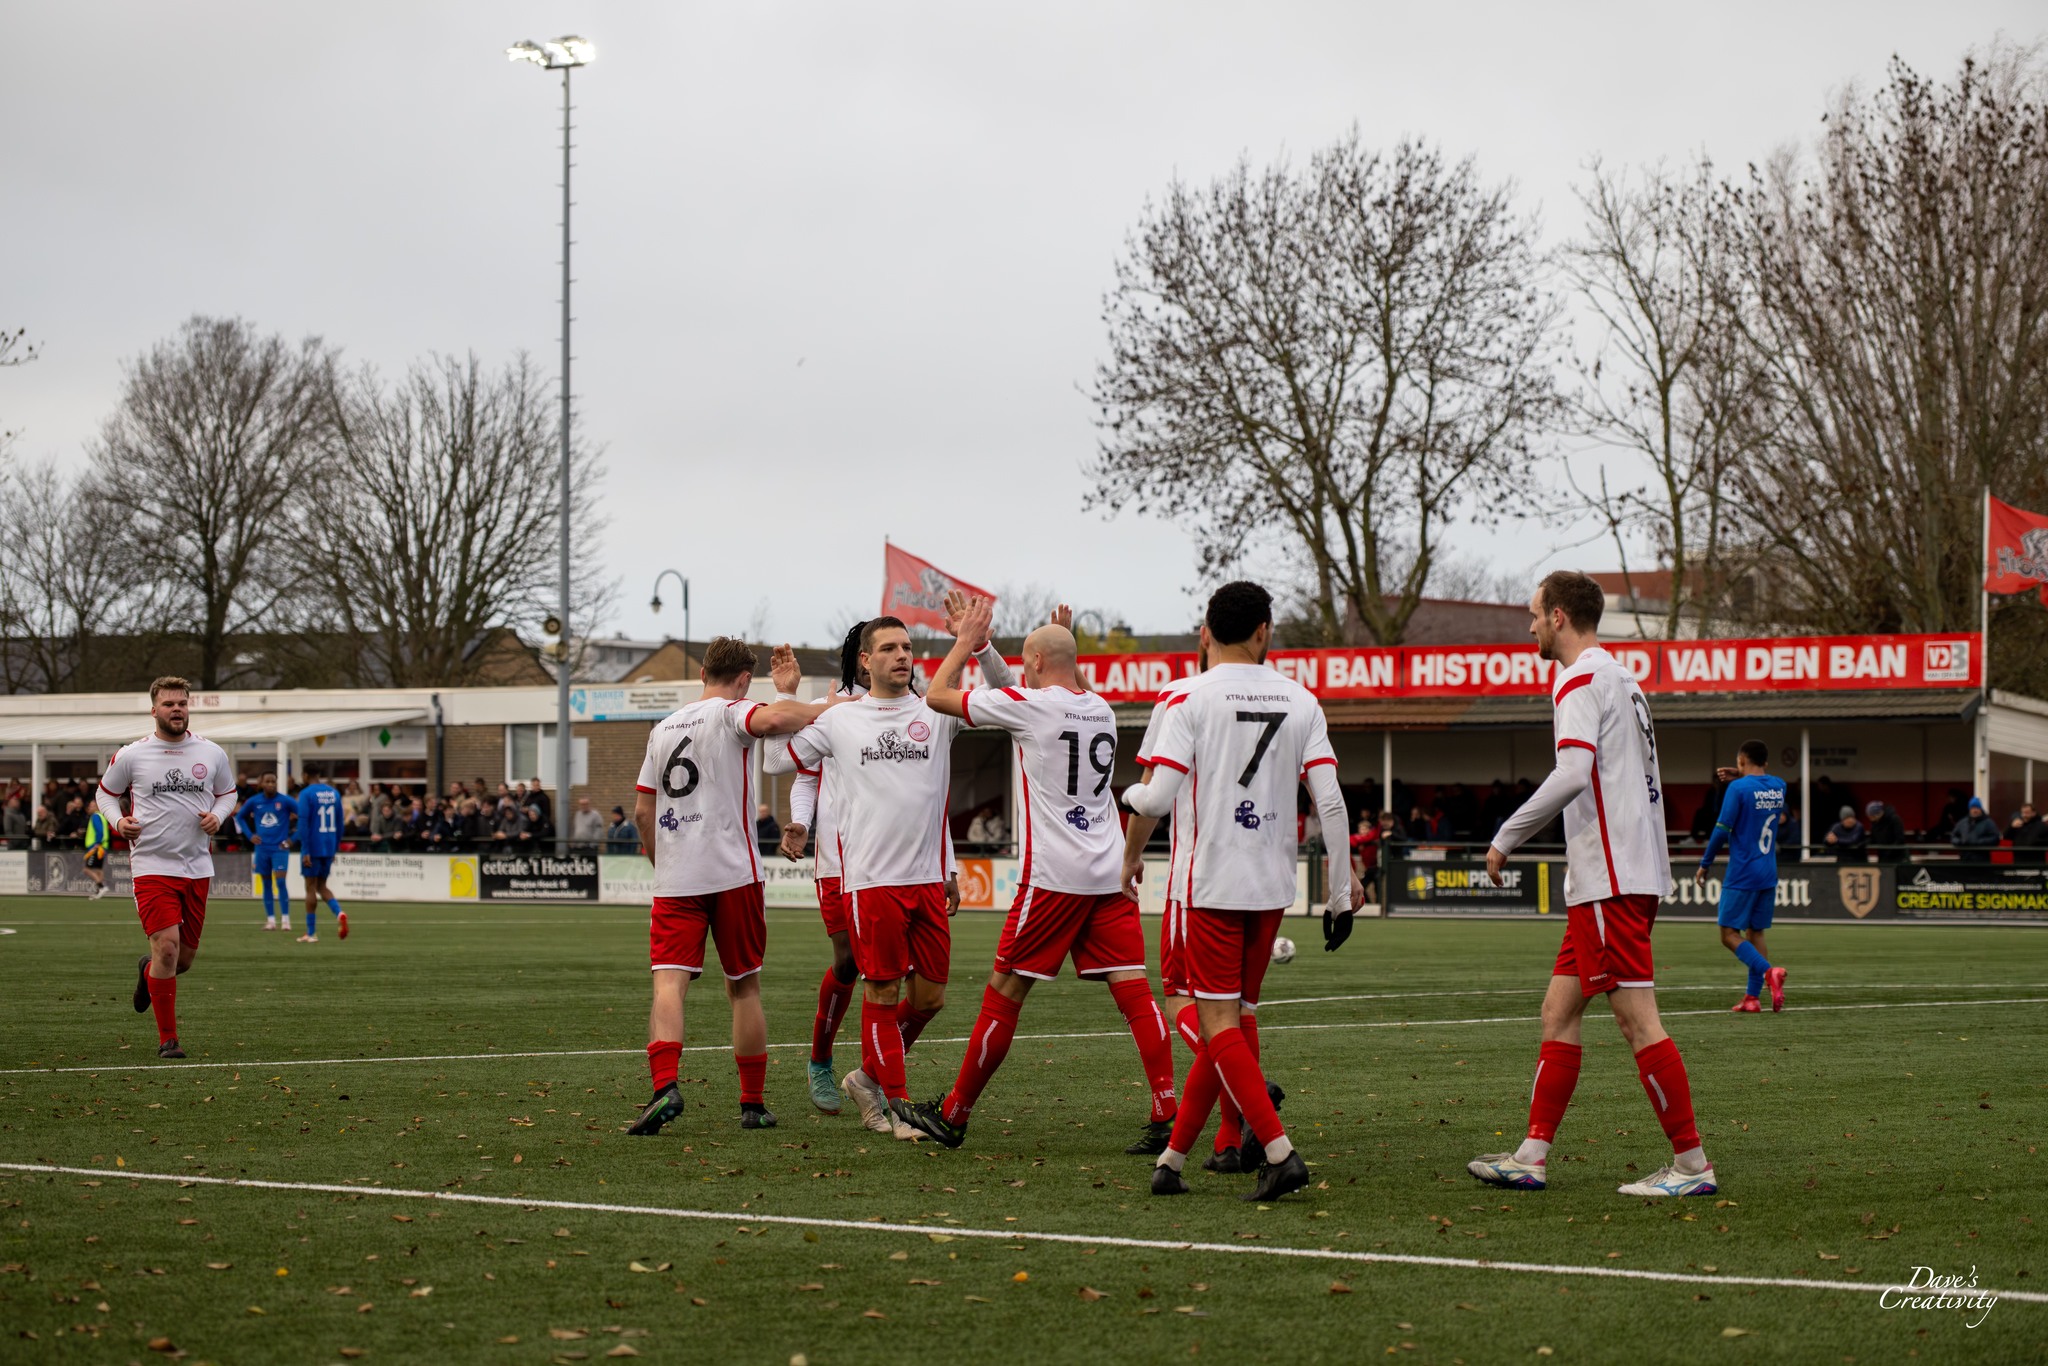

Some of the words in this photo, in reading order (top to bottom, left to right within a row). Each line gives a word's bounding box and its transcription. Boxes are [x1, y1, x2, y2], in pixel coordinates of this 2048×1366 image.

[1325, 655, 1394, 688] BAN
[1411, 650, 1652, 686] HISTORYD
[1667, 648, 1737, 682] VAN
[1745, 645, 1820, 681] DEN
[1829, 644, 1907, 679] BAN
[1225, 694, 1246, 702] XTRA
[1064, 712, 1081, 720] XTRA
[860, 745, 929, 766] Historyland
[1236, 711, 1288, 788] 7
[662, 735, 699, 798] 6
[1058, 731, 1116, 797] 19
[152, 781, 205, 796] Historyland
[317, 805, 337, 833] 11
[1758, 813, 1777, 855] 6
[541, 857, 597, 876] Hoeckie
[1435, 869, 1522, 888] SUNPROF
[1897, 892, 1973, 909] CREATIVE
[1976, 893, 2048, 910] SIGNMAK
